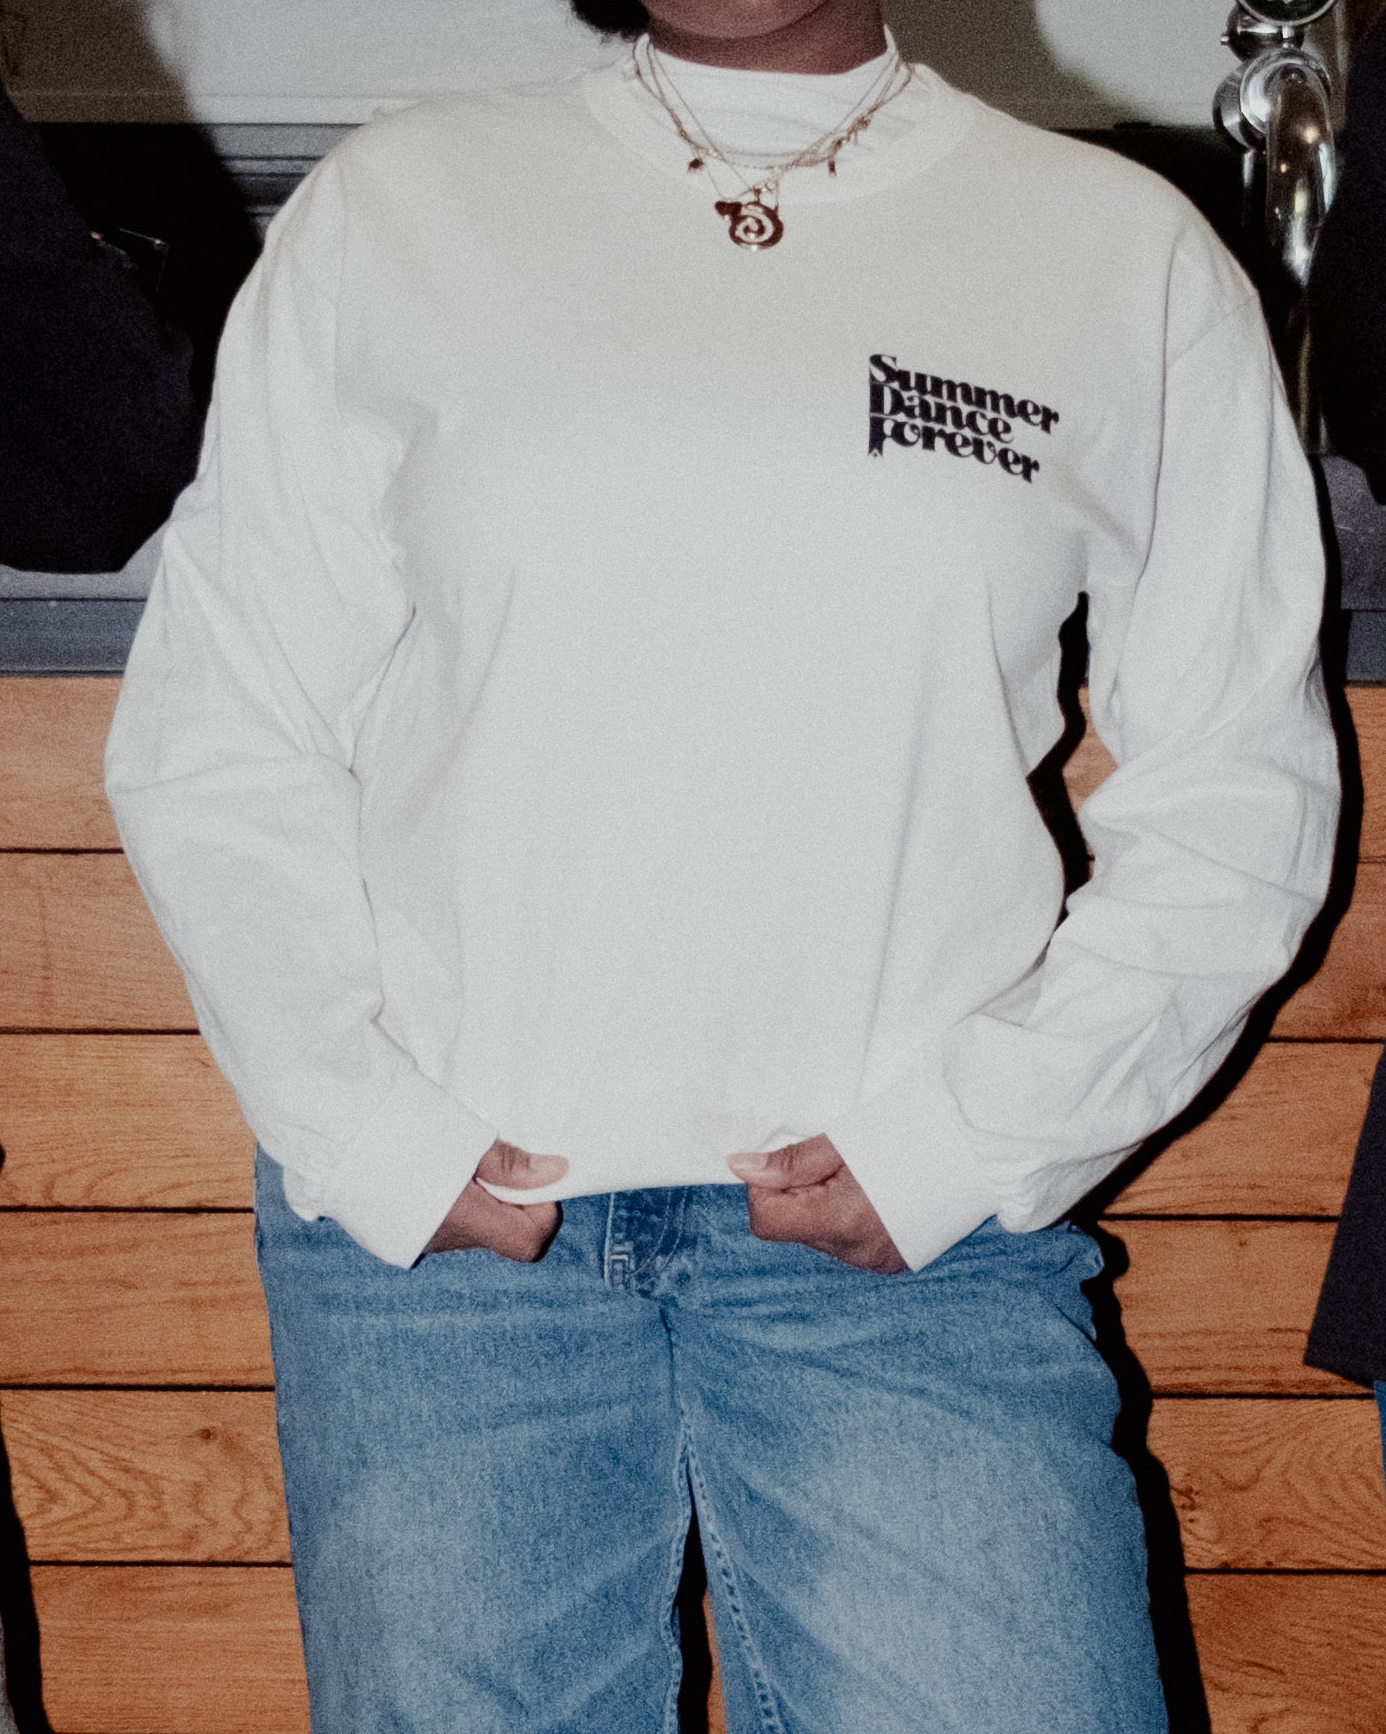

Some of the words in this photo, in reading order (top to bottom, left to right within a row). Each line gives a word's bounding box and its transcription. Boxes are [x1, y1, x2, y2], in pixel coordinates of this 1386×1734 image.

[869, 353, 1059, 434] Summer
[869, 383, 1014, 444] Dance
[868, 415, 1040, 484] Forever
